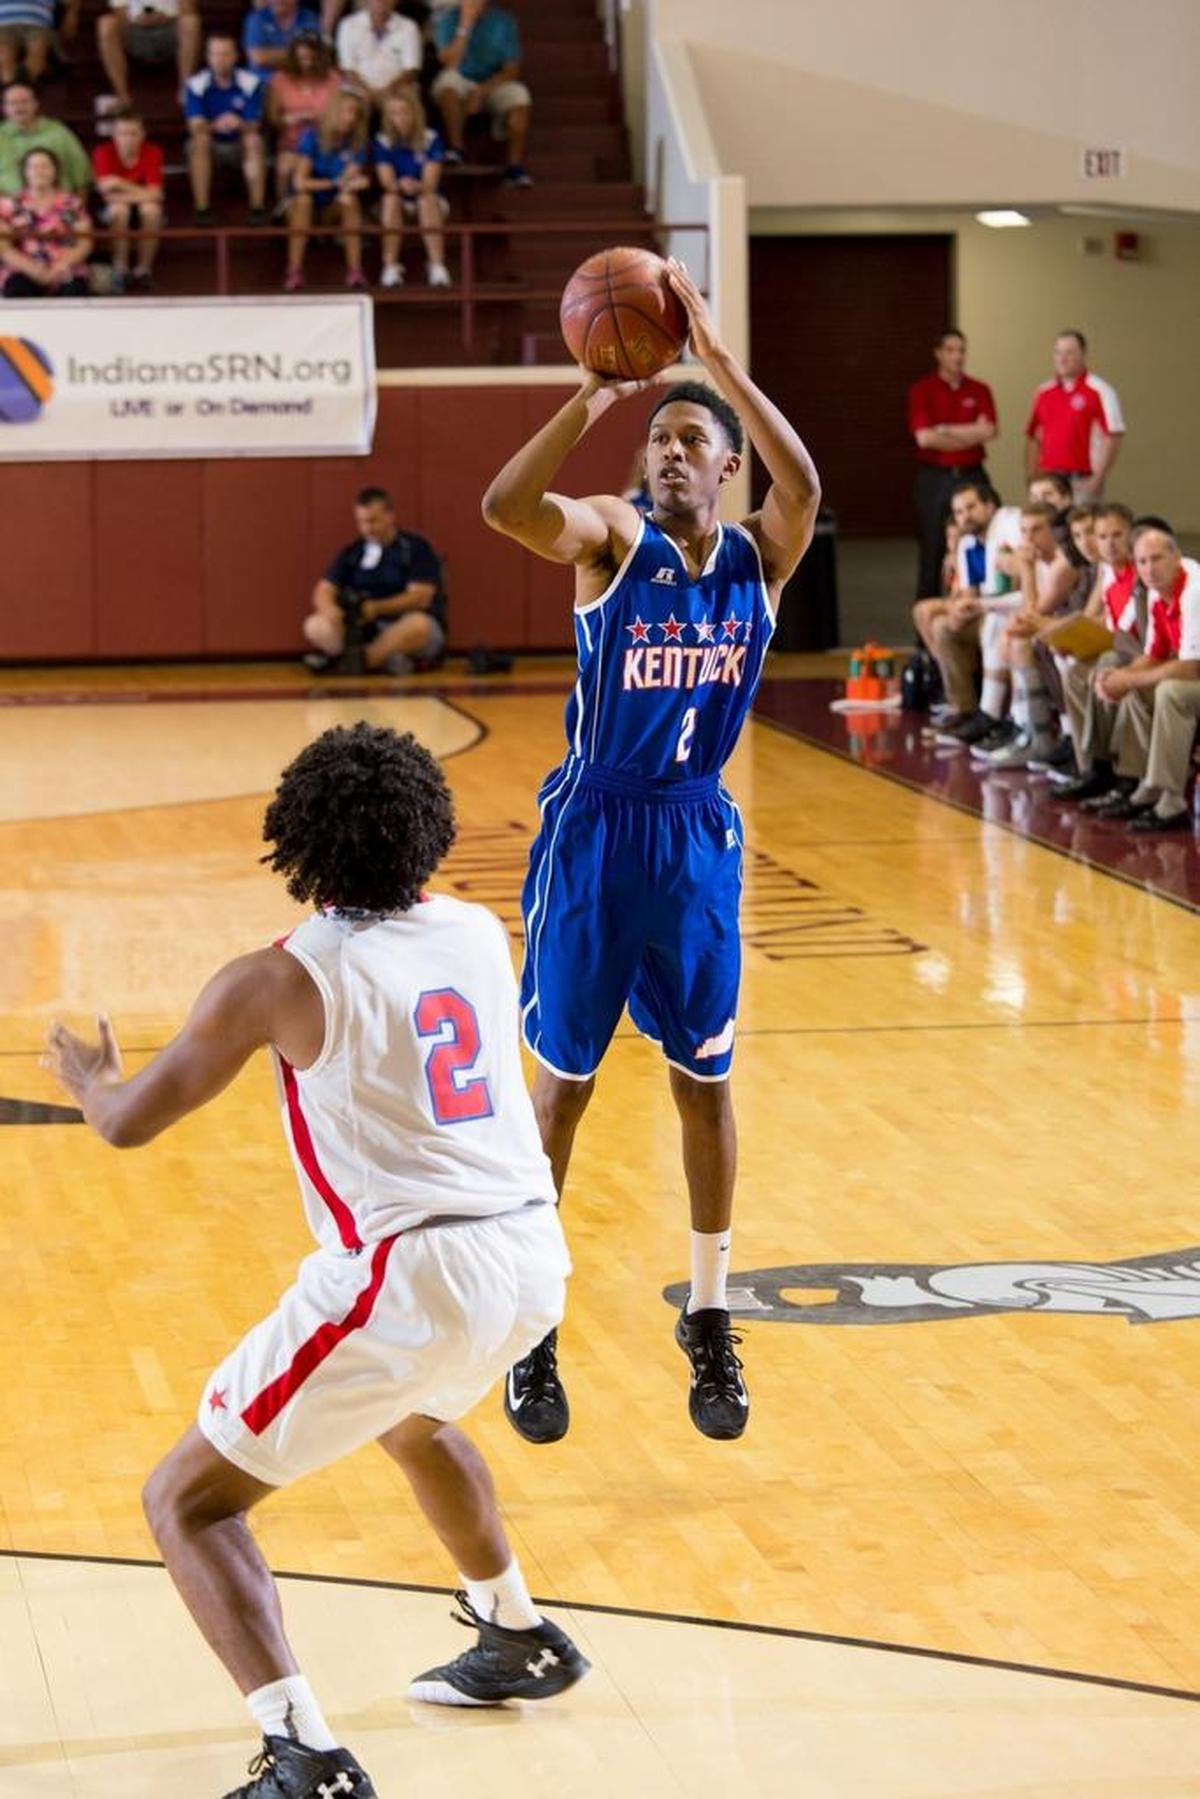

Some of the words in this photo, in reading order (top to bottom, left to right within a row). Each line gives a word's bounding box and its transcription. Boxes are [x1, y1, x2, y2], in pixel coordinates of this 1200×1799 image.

[1084, 149, 1121, 178] EXIT
[67, 353, 352, 385] IndianaSRN.org
[109, 399, 152, 417] LIVE
[164, 403, 183, 416] or
[195, 399, 224, 416] On
[230, 398, 313, 415] Demand
[622, 643, 746, 691] KENTUCK
[675, 706, 697, 762] 2
[413, 986, 495, 1126] 2
